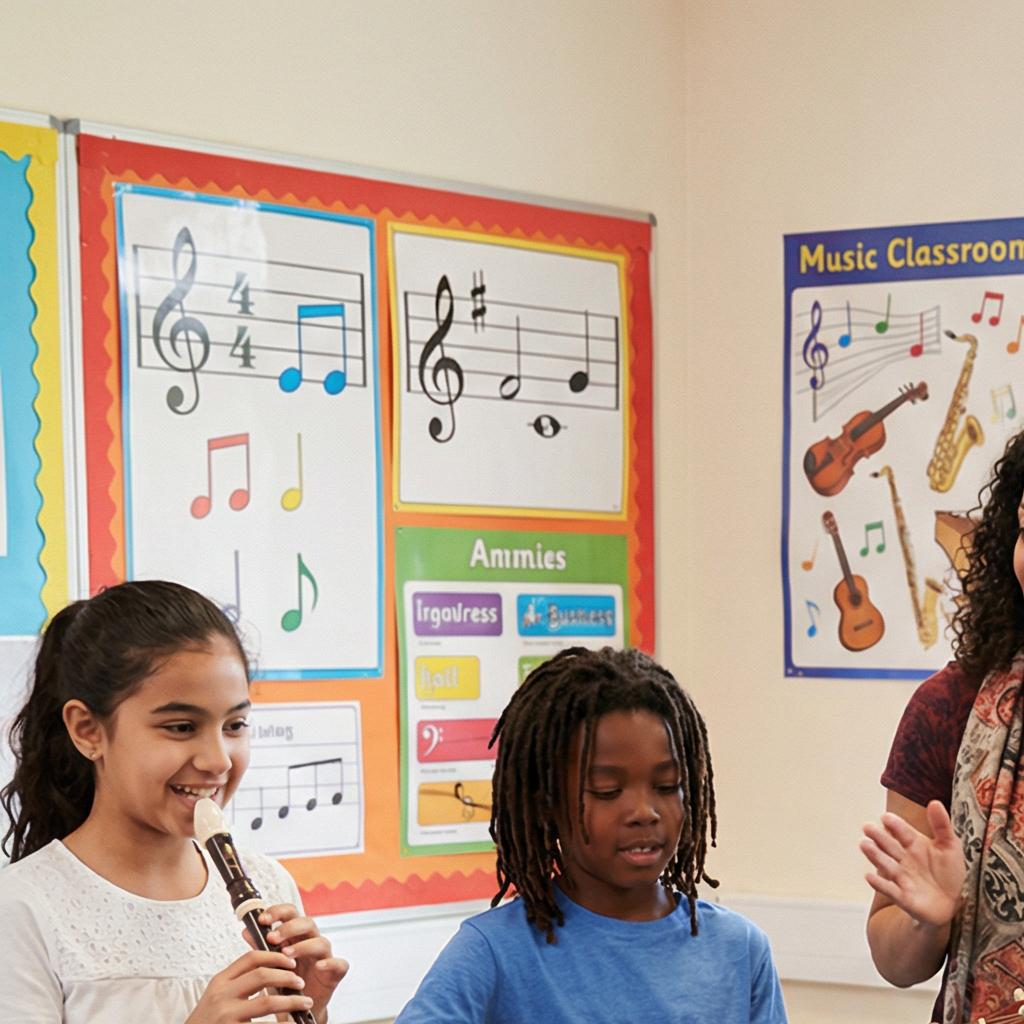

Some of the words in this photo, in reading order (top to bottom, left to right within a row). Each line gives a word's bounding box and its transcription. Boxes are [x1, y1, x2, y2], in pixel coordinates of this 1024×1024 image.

[799, 242, 877, 274] Music
[227, 271, 255, 315] 4
[229, 325, 256, 369] 4
